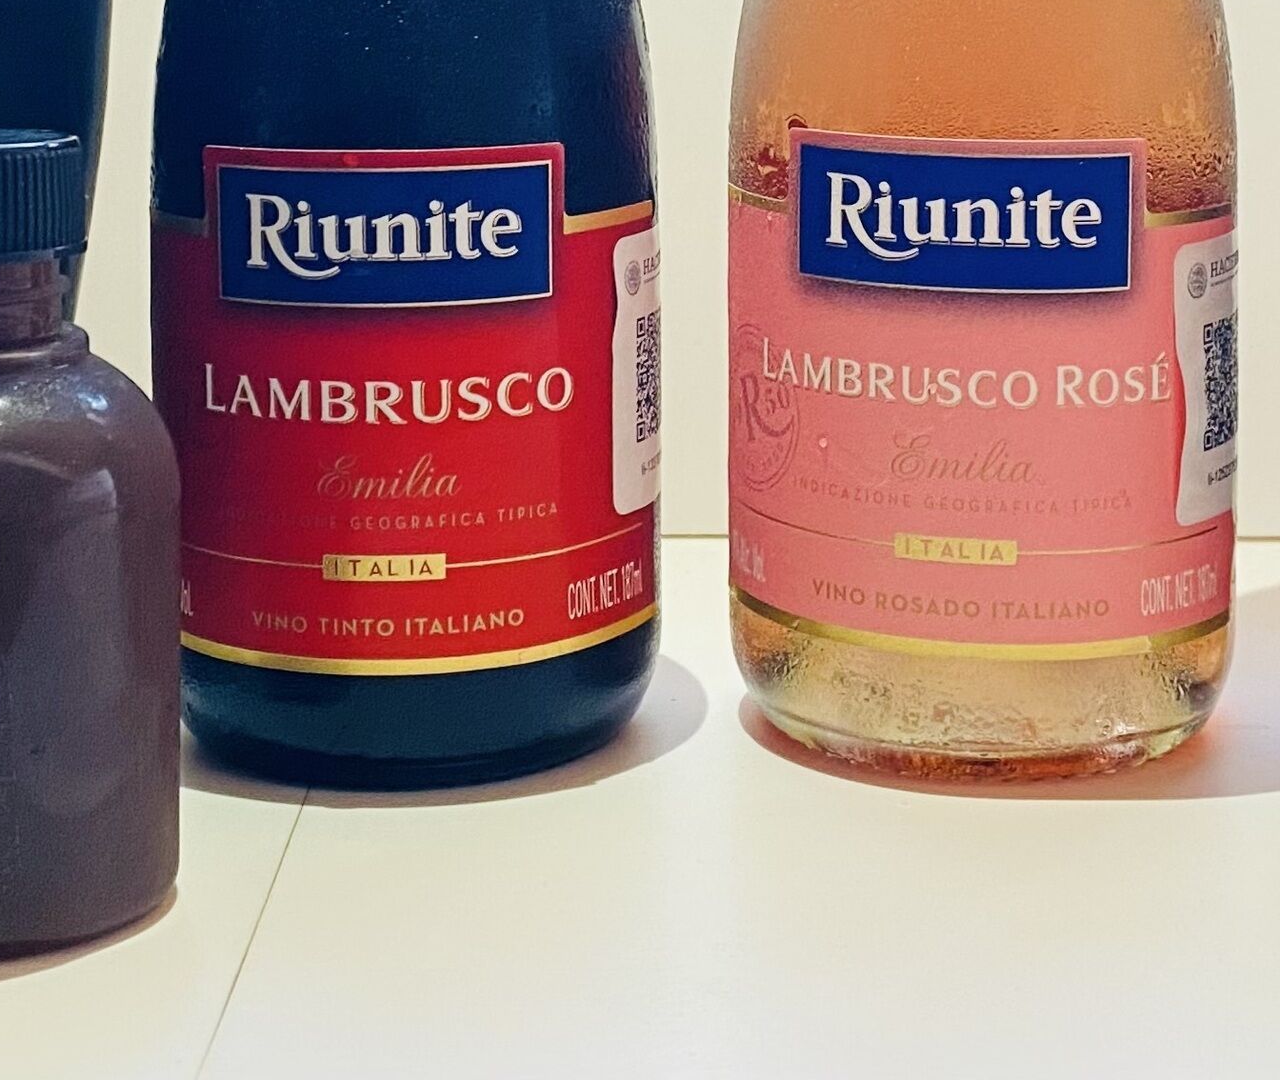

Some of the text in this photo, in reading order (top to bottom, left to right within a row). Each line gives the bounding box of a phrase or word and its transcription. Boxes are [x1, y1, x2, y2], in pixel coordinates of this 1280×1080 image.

[245, 193, 523, 281] Riunite
[825, 171, 1103, 261] Riunite
[205, 363, 575, 425] LAMBRUSCO
[762, 337, 1039, 409] LAMBRUSCO
[1056, 353, 1173, 408] ROSÉ
[317, 453, 462, 501] Emilia
[890, 431, 1037, 483] Emilia
[350, 510, 486, 532] GEOGRAFICA
[497, 502, 559, 523] TIPICA
[794, 476, 911, 510] INDICAZIONE
[923, 495, 1058, 515] GEOGRAFICA
[332, 557, 434, 577] ITALIA
[904, 539, 1005, 562] ITALIA
[568, 575, 598, 620] CONT.
[599, 568, 621, 610] NET.
[812, 580, 1110, 621] VINO ROSADO ITALIANO
[1141, 575, 1173, 616] CONT.
[251, 608, 525, 638] VINO TINTO ITALIANO
